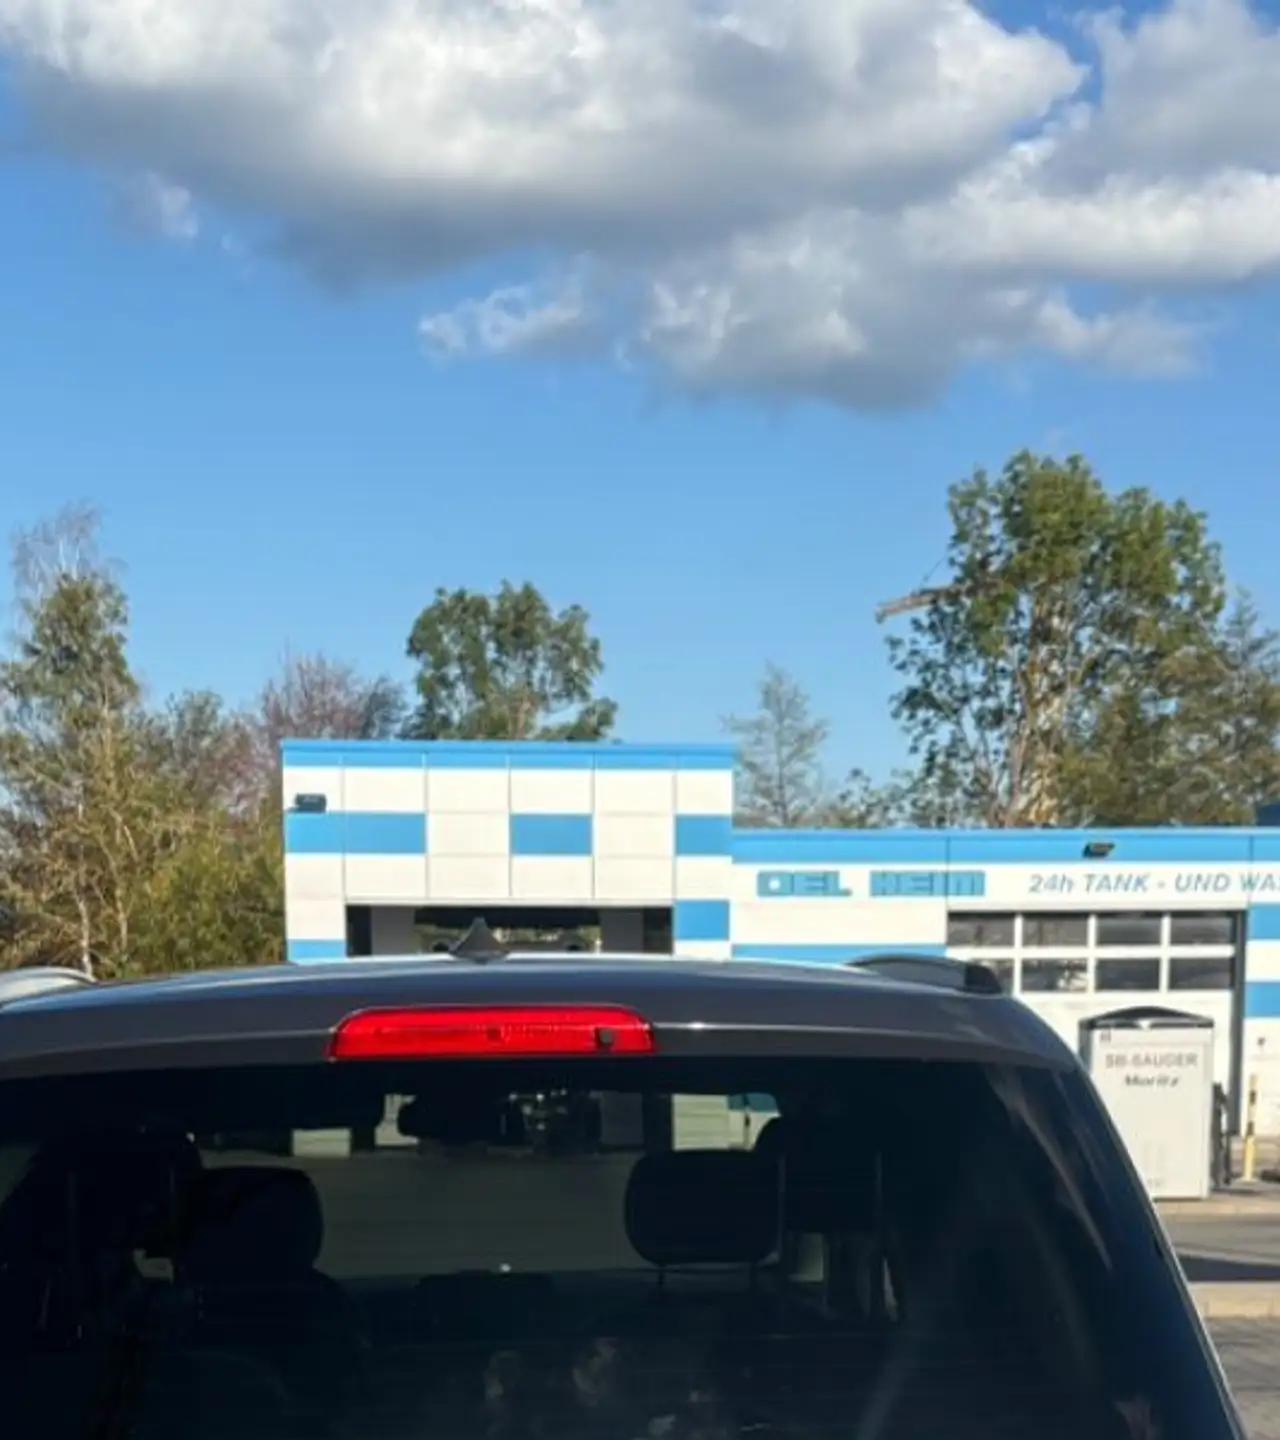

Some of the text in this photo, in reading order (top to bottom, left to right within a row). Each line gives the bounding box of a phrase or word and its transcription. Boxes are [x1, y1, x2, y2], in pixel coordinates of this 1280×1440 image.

[1029, 873, 1073, 894] 24h
[1083, 873, 1151, 893] TANK
[1174, 873, 1232, 893] UND
